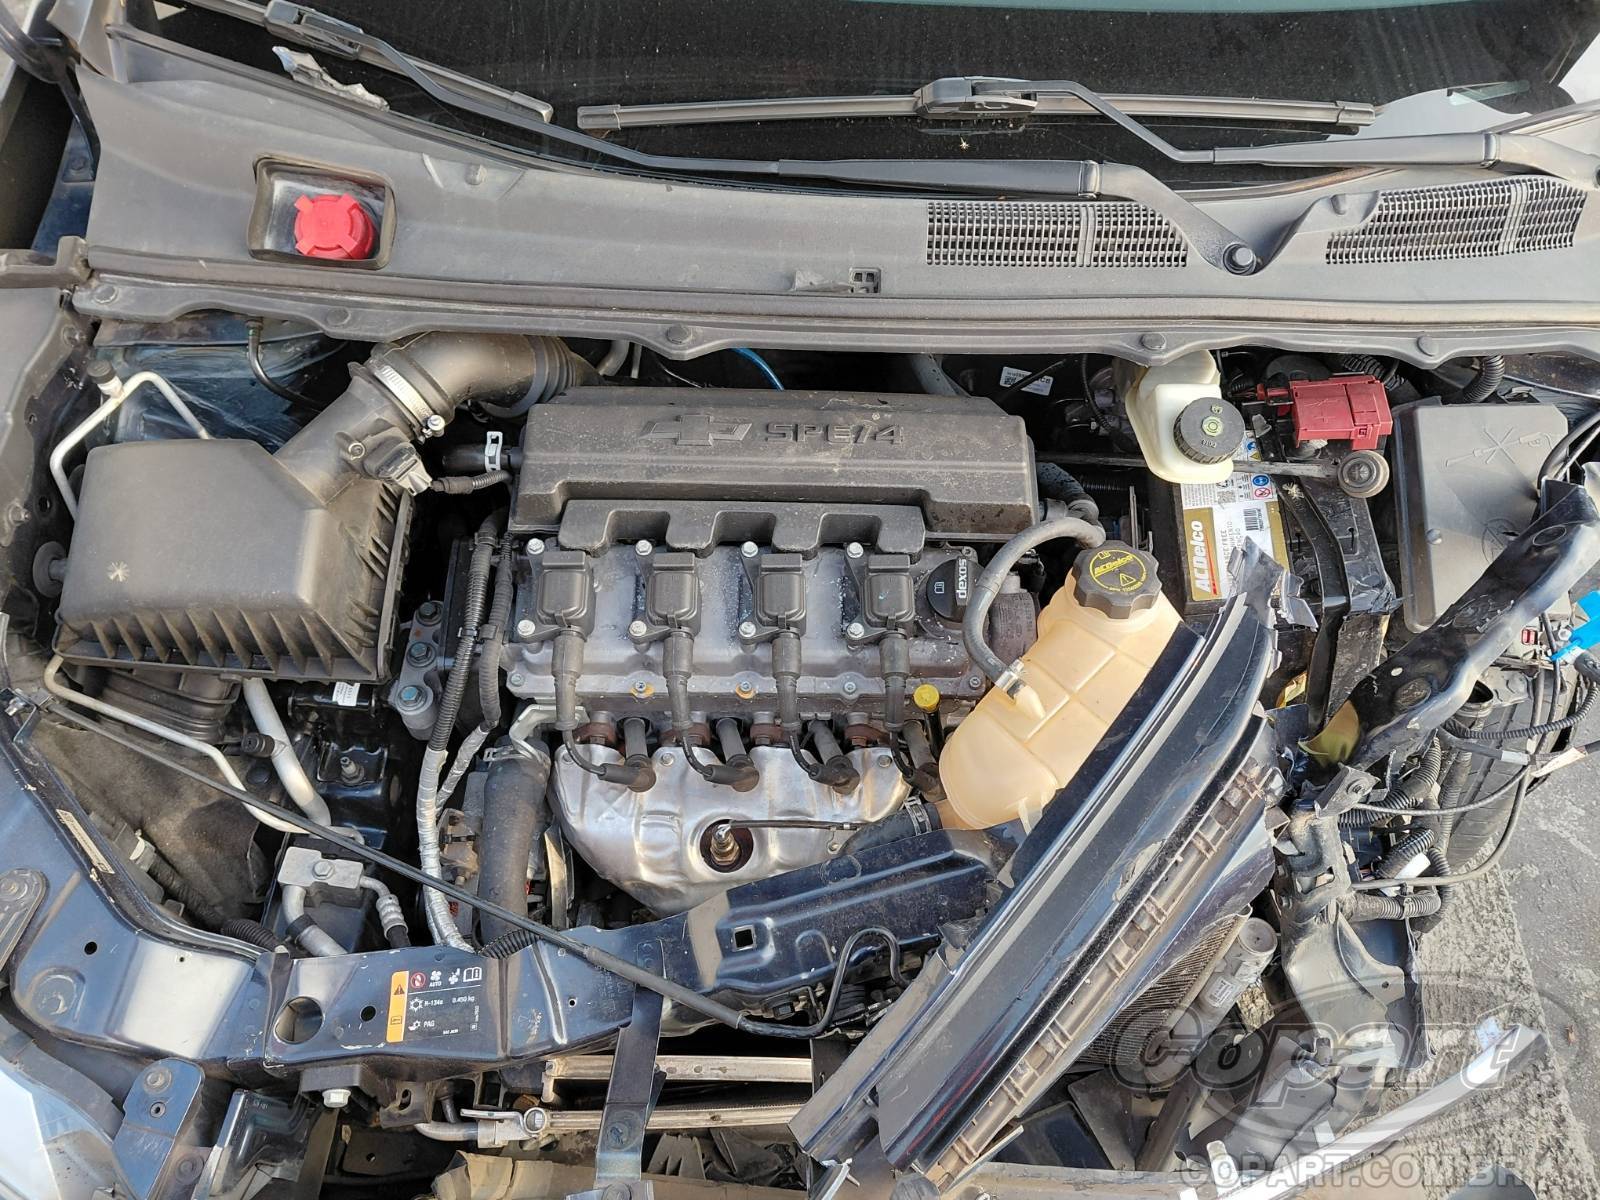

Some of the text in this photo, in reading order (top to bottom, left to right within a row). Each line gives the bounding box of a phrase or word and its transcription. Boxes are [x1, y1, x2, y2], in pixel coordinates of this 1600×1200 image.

[1190, 520, 1211, 594] ACDelco
[956, 559, 968, 599] dexos
[423, 1020, 435, 1028] PAG
